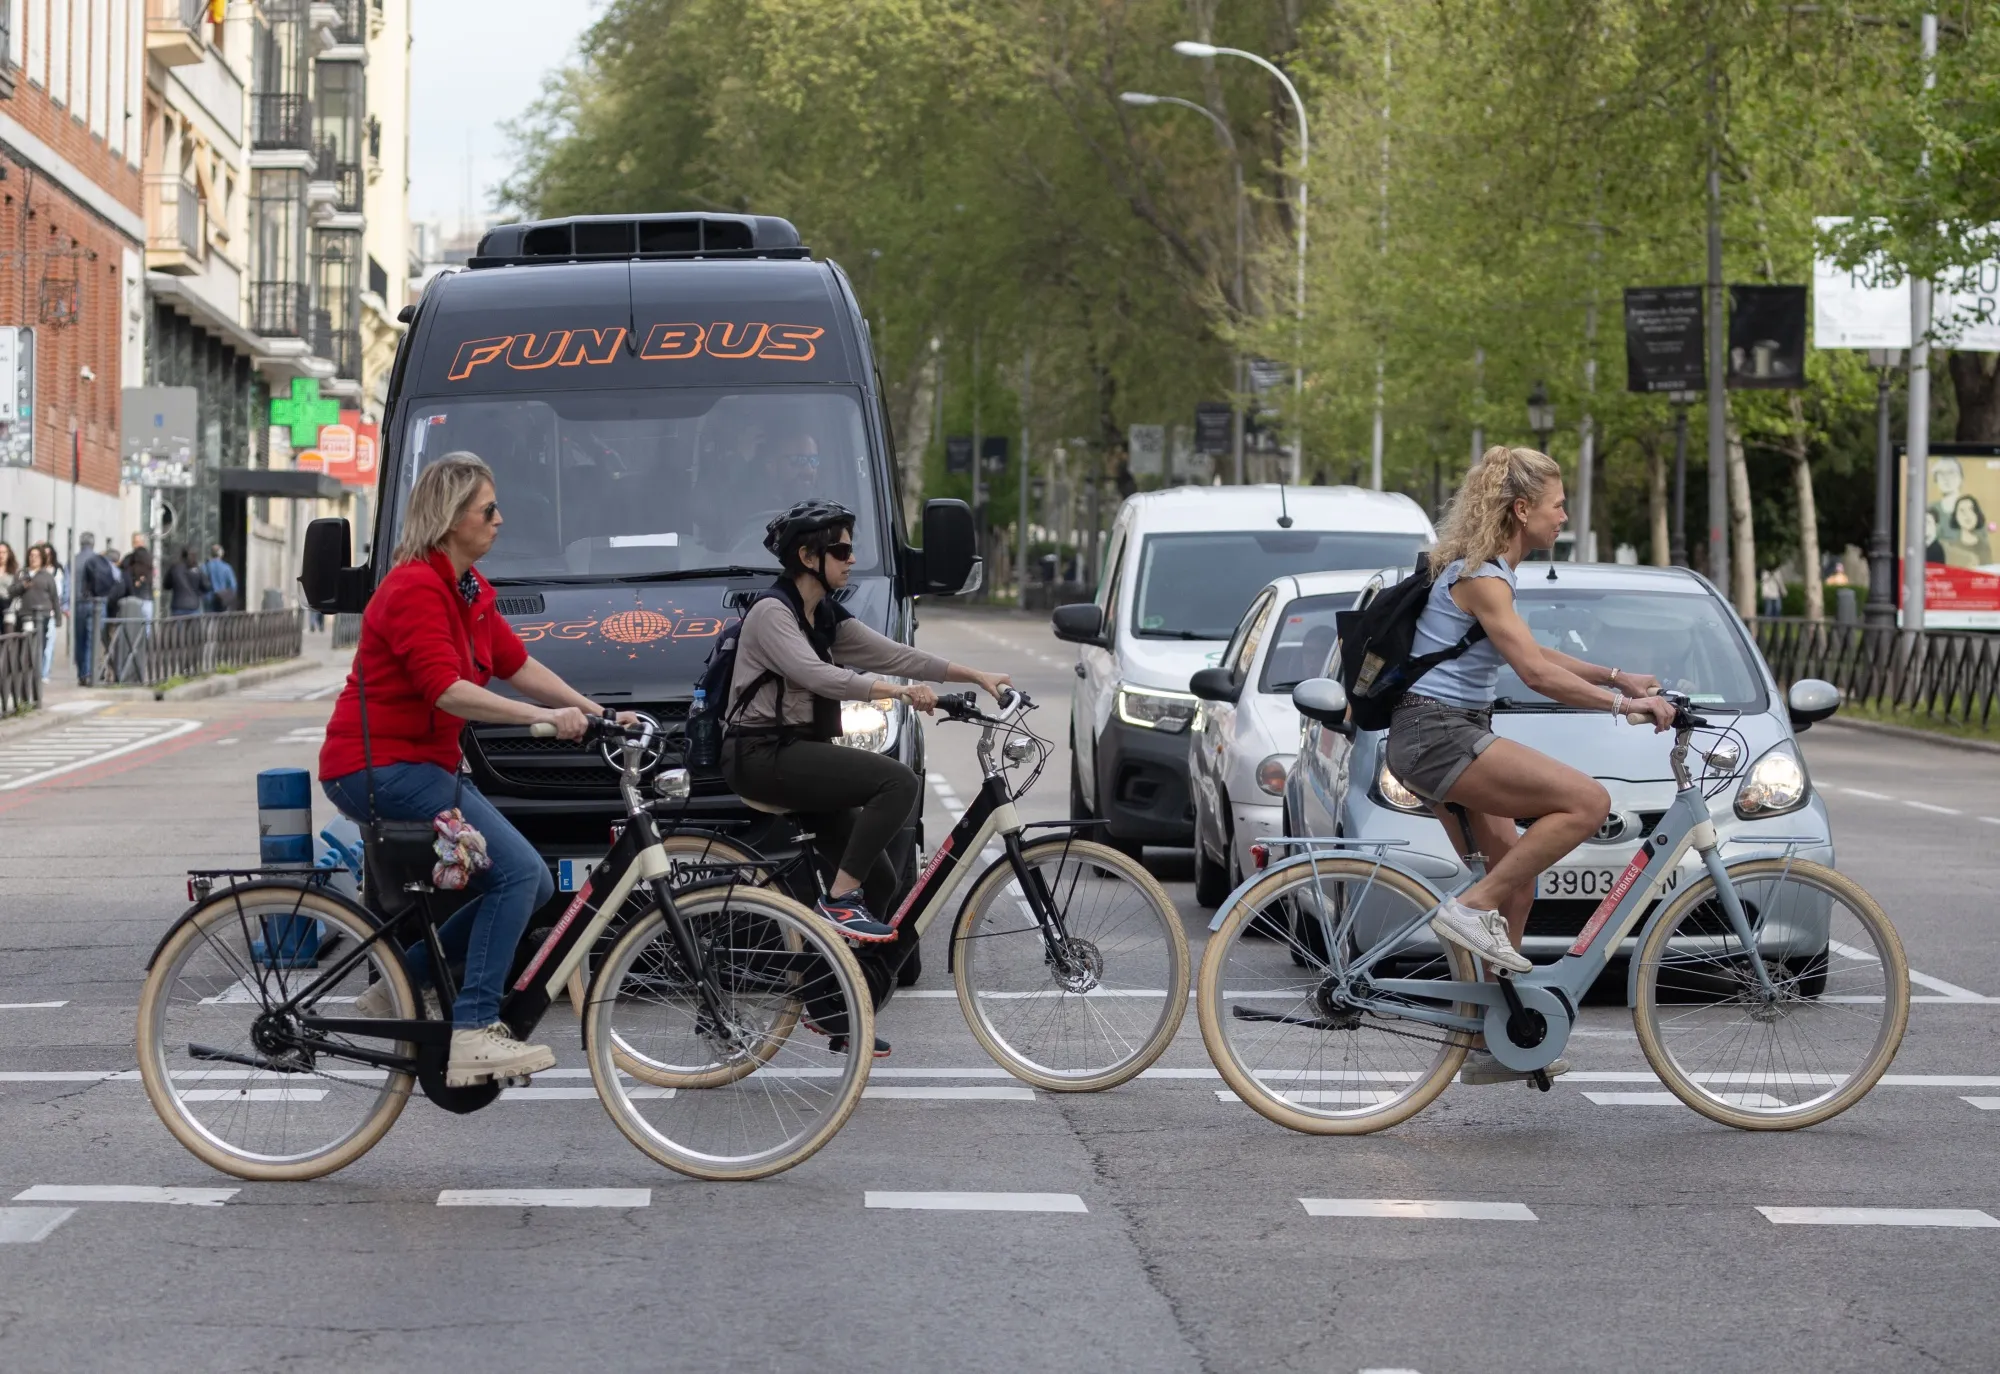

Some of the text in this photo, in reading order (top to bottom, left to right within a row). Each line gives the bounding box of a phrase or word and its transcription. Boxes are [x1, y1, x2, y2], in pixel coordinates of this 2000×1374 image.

[1978, 297, 2000, 326] R
[447, 322, 825, 381] FUN BUS
[922, 848, 947, 881] TIMBIKES
[563, 878, 569, 886] E
[1544, 870, 1614, 895] 3903
[1610, 864, 1640, 902] TIMBIKES
[554, 895, 584, 936] TIMBIKES
